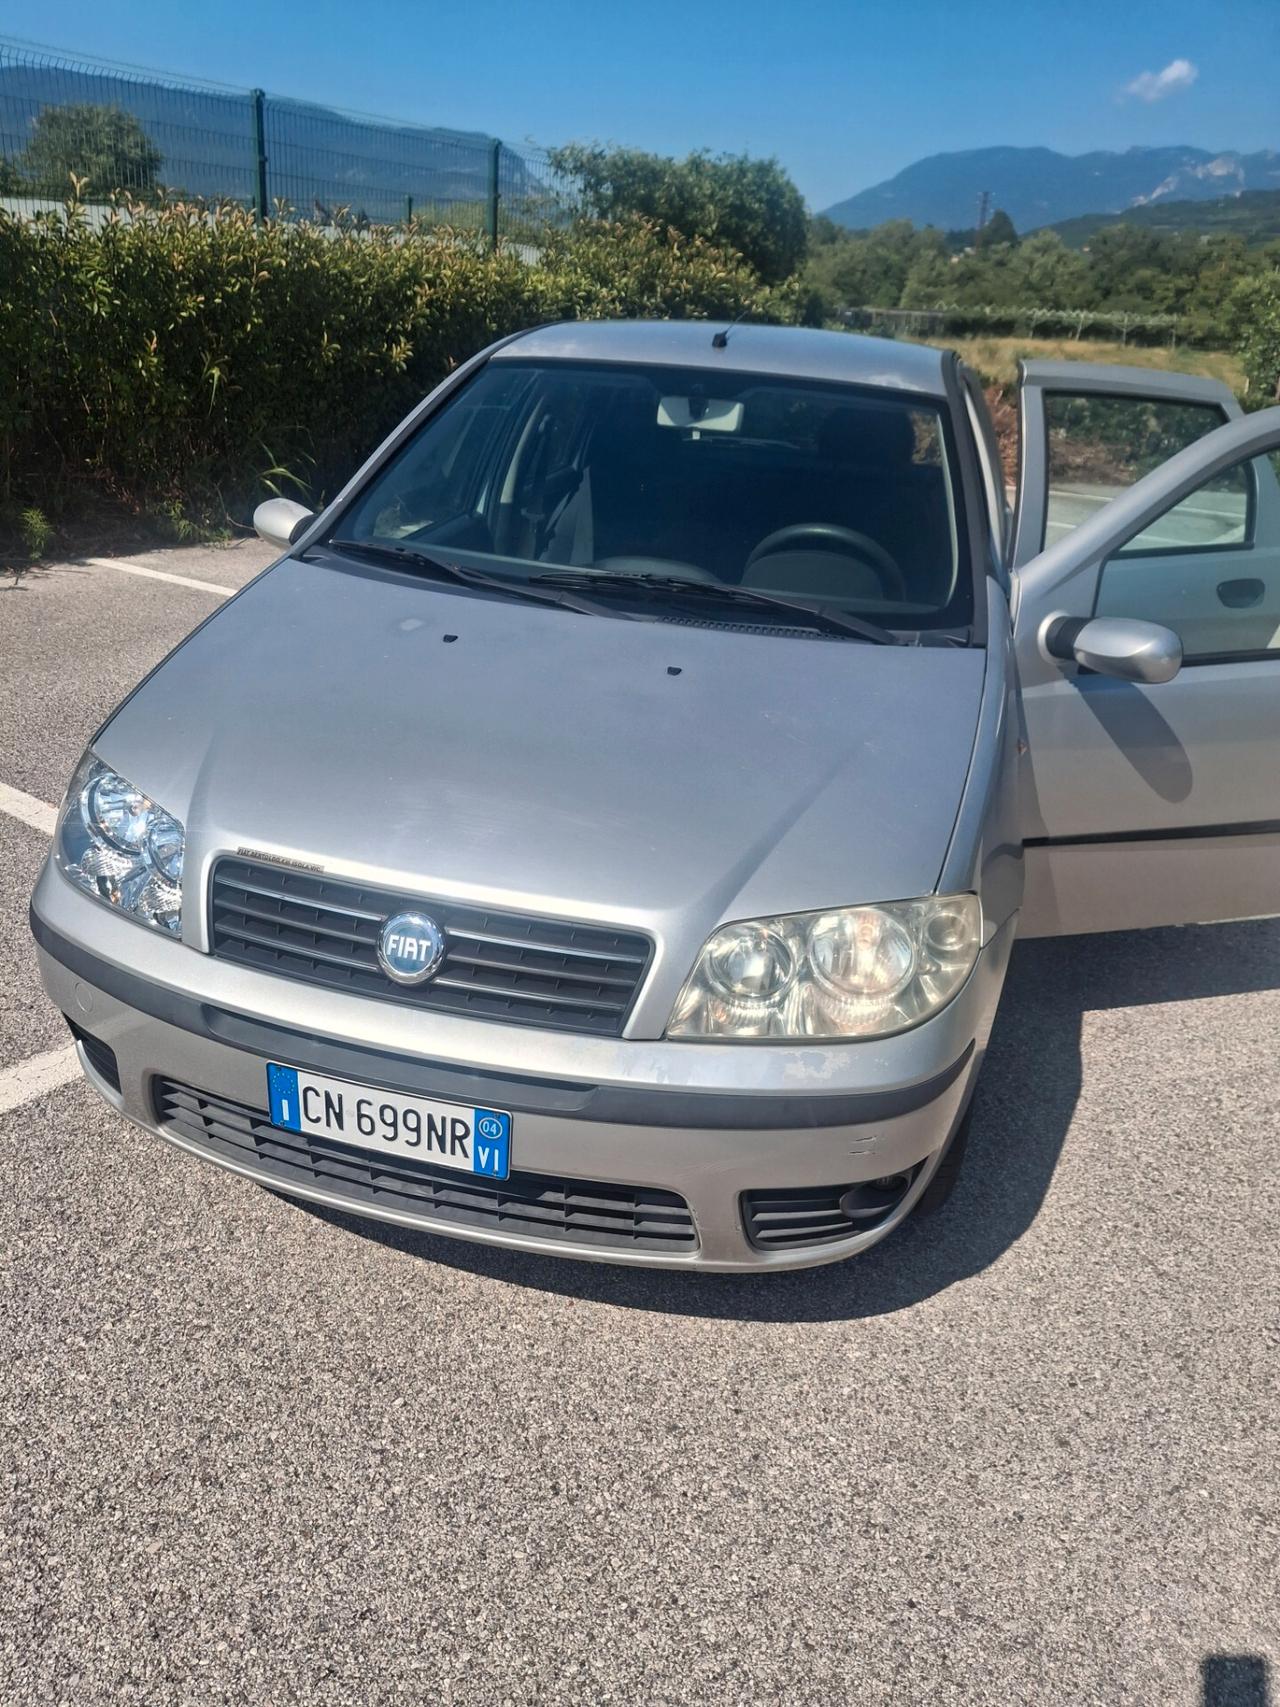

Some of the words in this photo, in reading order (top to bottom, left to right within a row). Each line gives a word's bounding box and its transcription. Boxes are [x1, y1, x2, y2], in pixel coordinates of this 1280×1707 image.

[386, 934, 431, 962] FIAT
[281, 1099, 290, 1121] I
[302, 1086, 344, 1131] CN
[356, 1098, 471, 1159] 699NR
[482, 1120, 497, 1136] 04
[478, 1145, 499, 1172] VI
